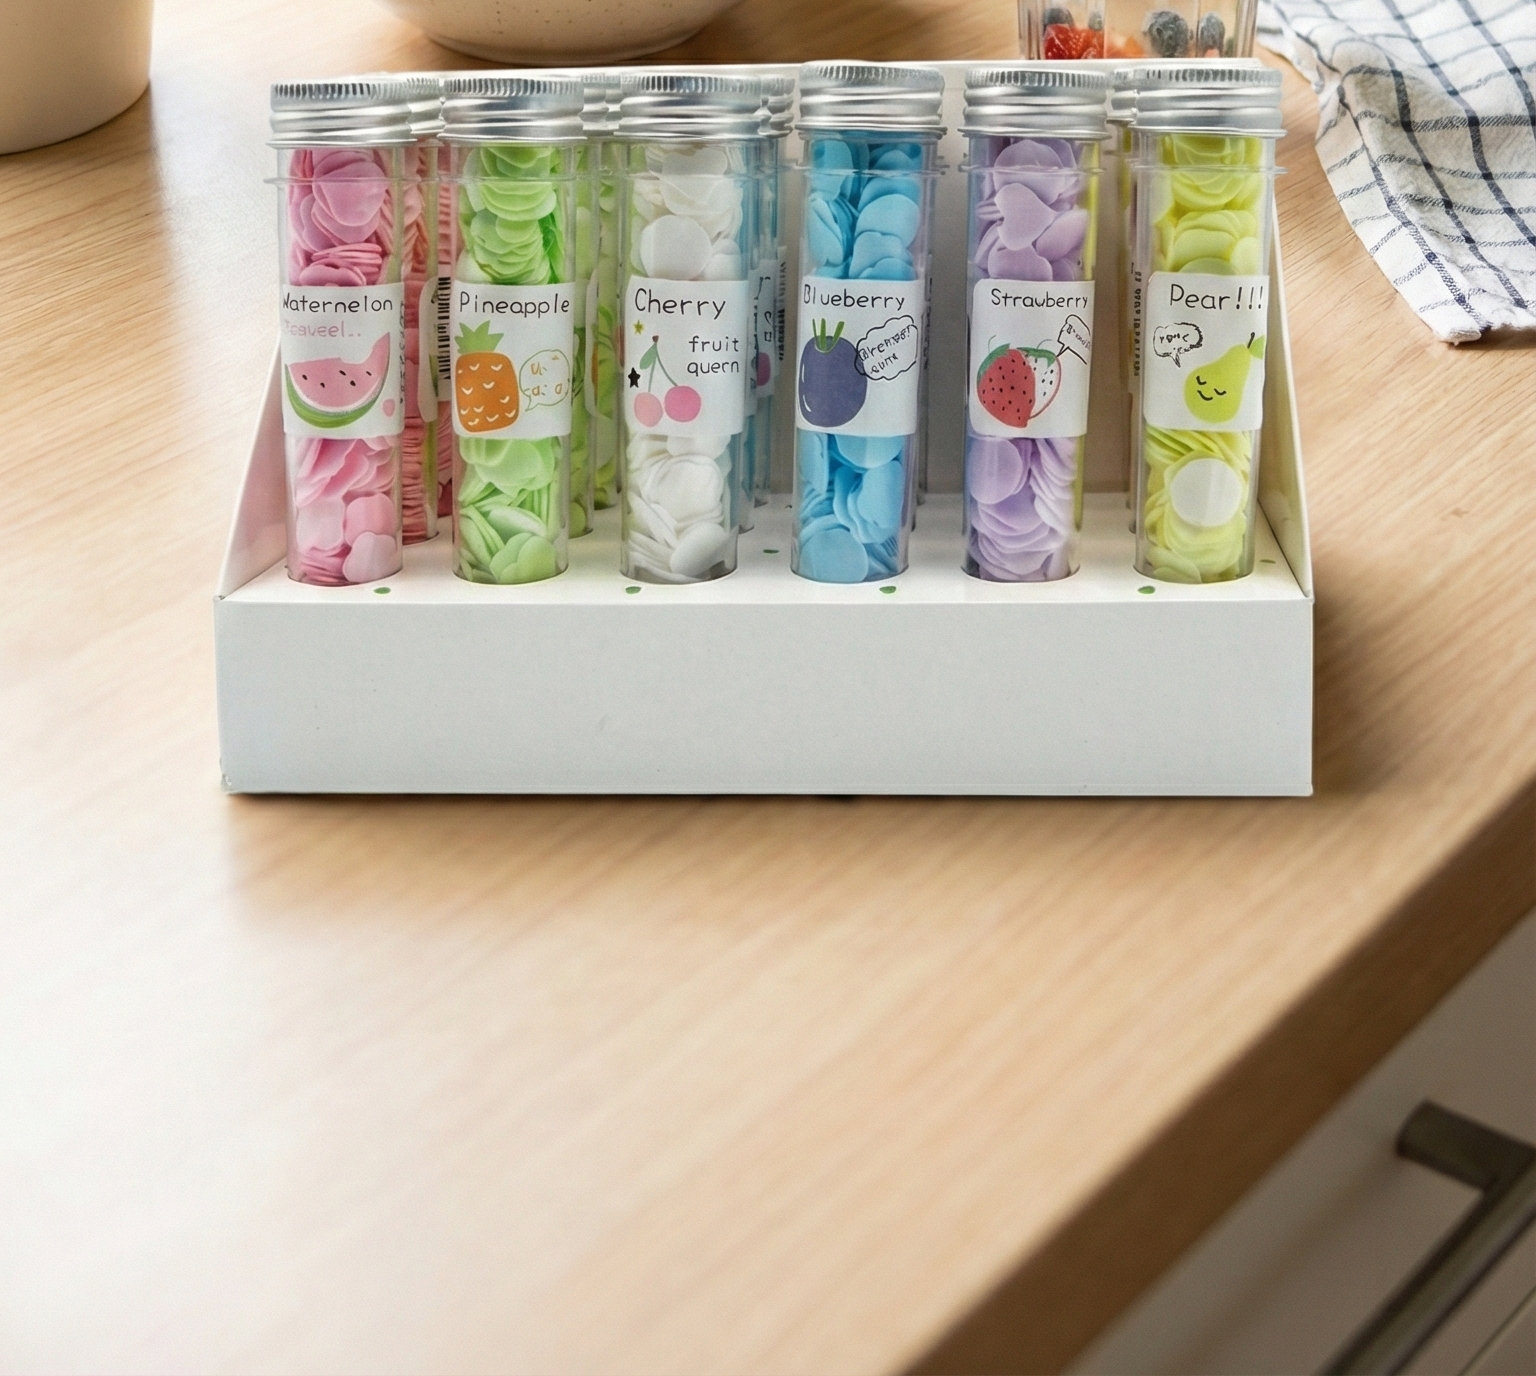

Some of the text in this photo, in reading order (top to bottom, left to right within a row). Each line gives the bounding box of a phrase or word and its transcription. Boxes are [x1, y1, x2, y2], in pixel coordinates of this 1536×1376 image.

[459, 291, 570, 319] Pineapple
[634, 287, 726, 320] Cherry
[803, 283, 905, 311] Blueberry
[1170, 283, 1263, 310] Pear!!!
[688, 335, 739, 353] fruit
